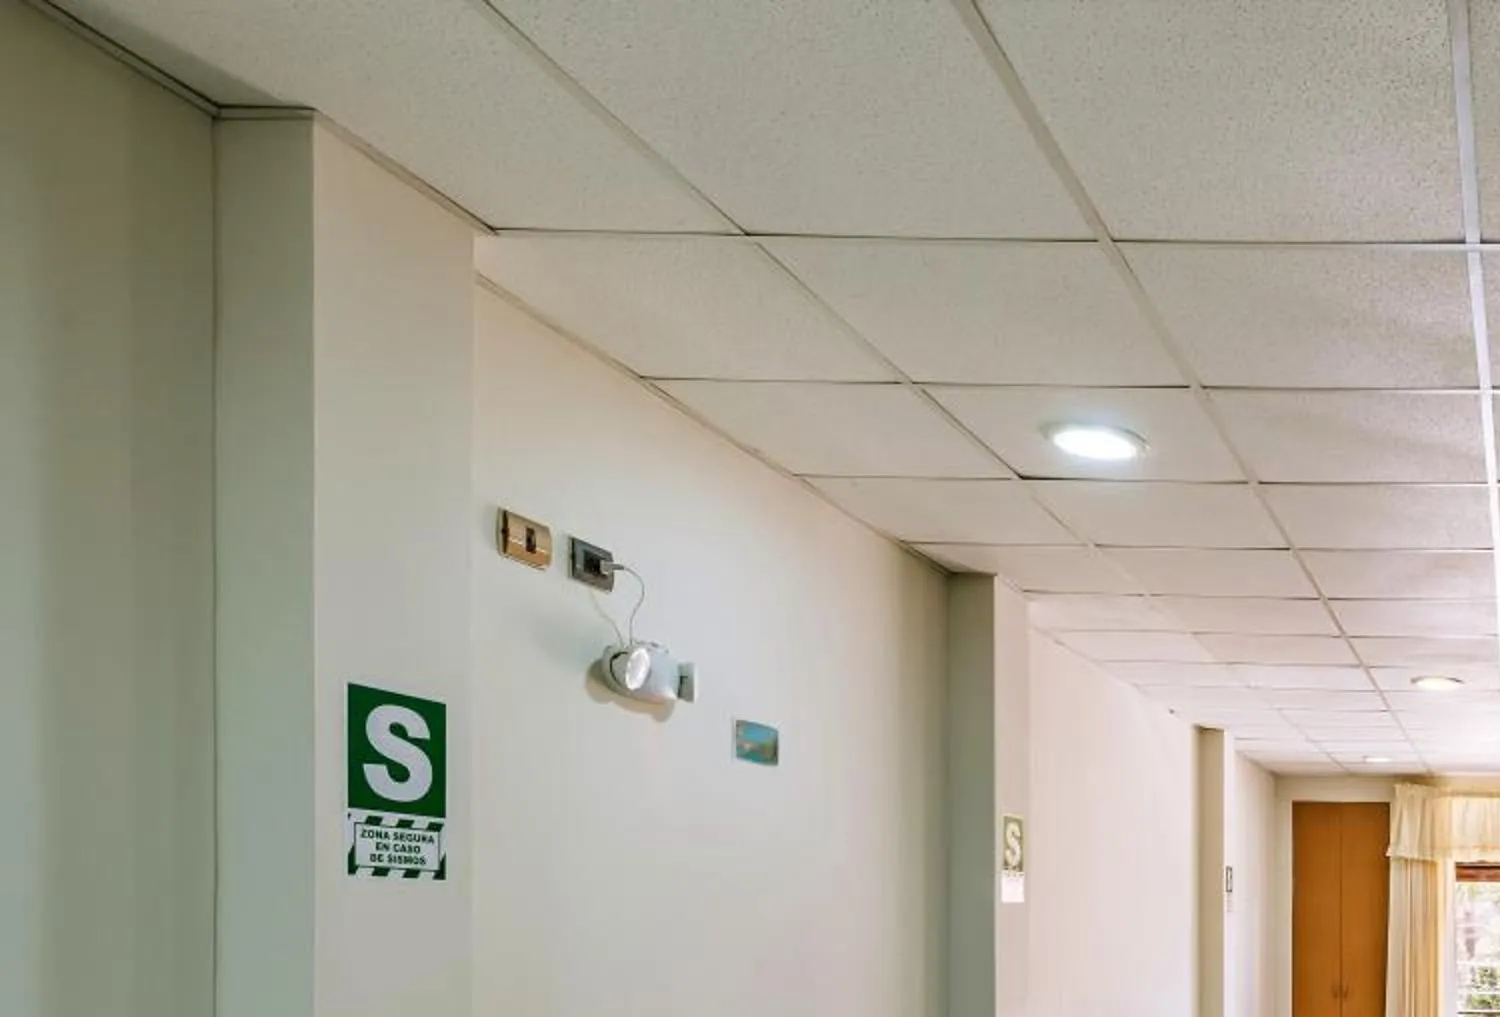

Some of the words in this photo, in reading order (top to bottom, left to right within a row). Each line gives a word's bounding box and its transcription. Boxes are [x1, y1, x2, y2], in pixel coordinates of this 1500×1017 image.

[363, 704, 433, 803] S
[361, 829, 390, 841] ZONA
[393, 831, 435, 845] SEGURA
[1005, 821, 1021, 867] S
[375, 842, 390, 851] EN
[393, 843, 421, 854] CASO
[369, 853, 385, 863] DE
